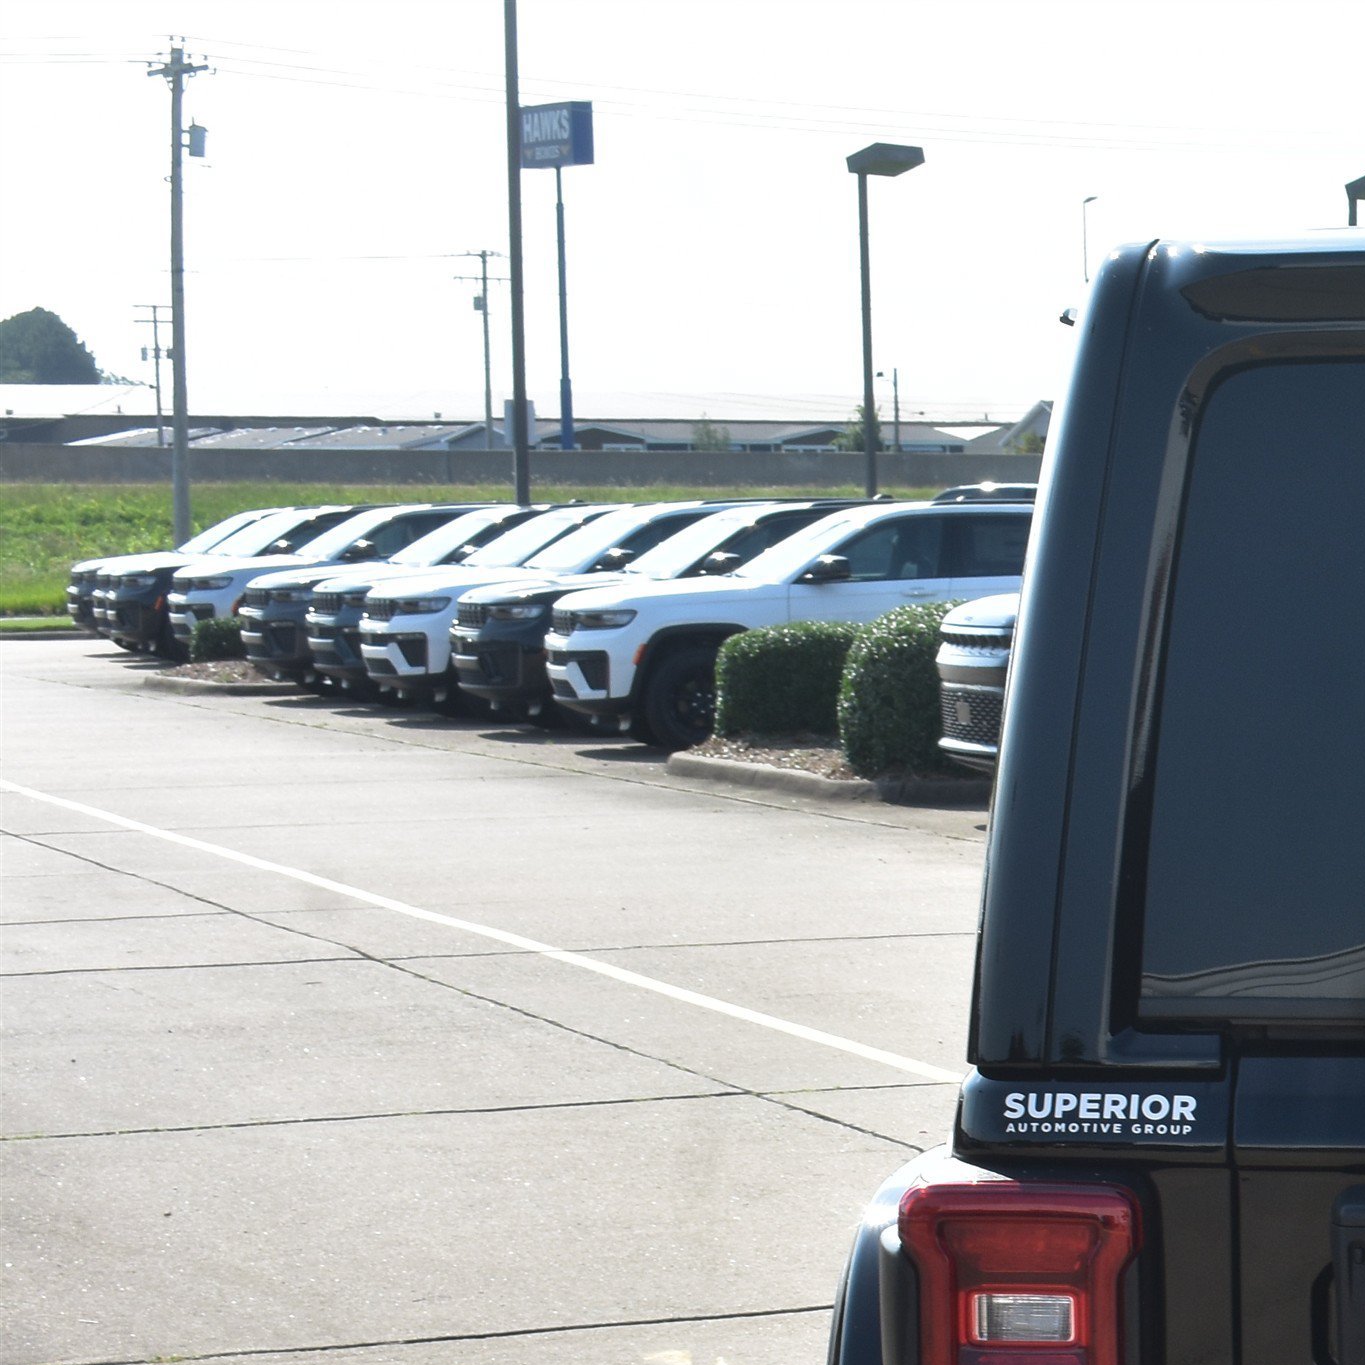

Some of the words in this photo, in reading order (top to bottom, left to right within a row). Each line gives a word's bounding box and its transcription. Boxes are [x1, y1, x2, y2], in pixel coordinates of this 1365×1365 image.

[1003, 1092, 1197, 1121] SUPERIOR
[1005, 1122, 1122, 1134] AUTOMOTIVE
[1131, 1124, 1193, 1135] GROUP
